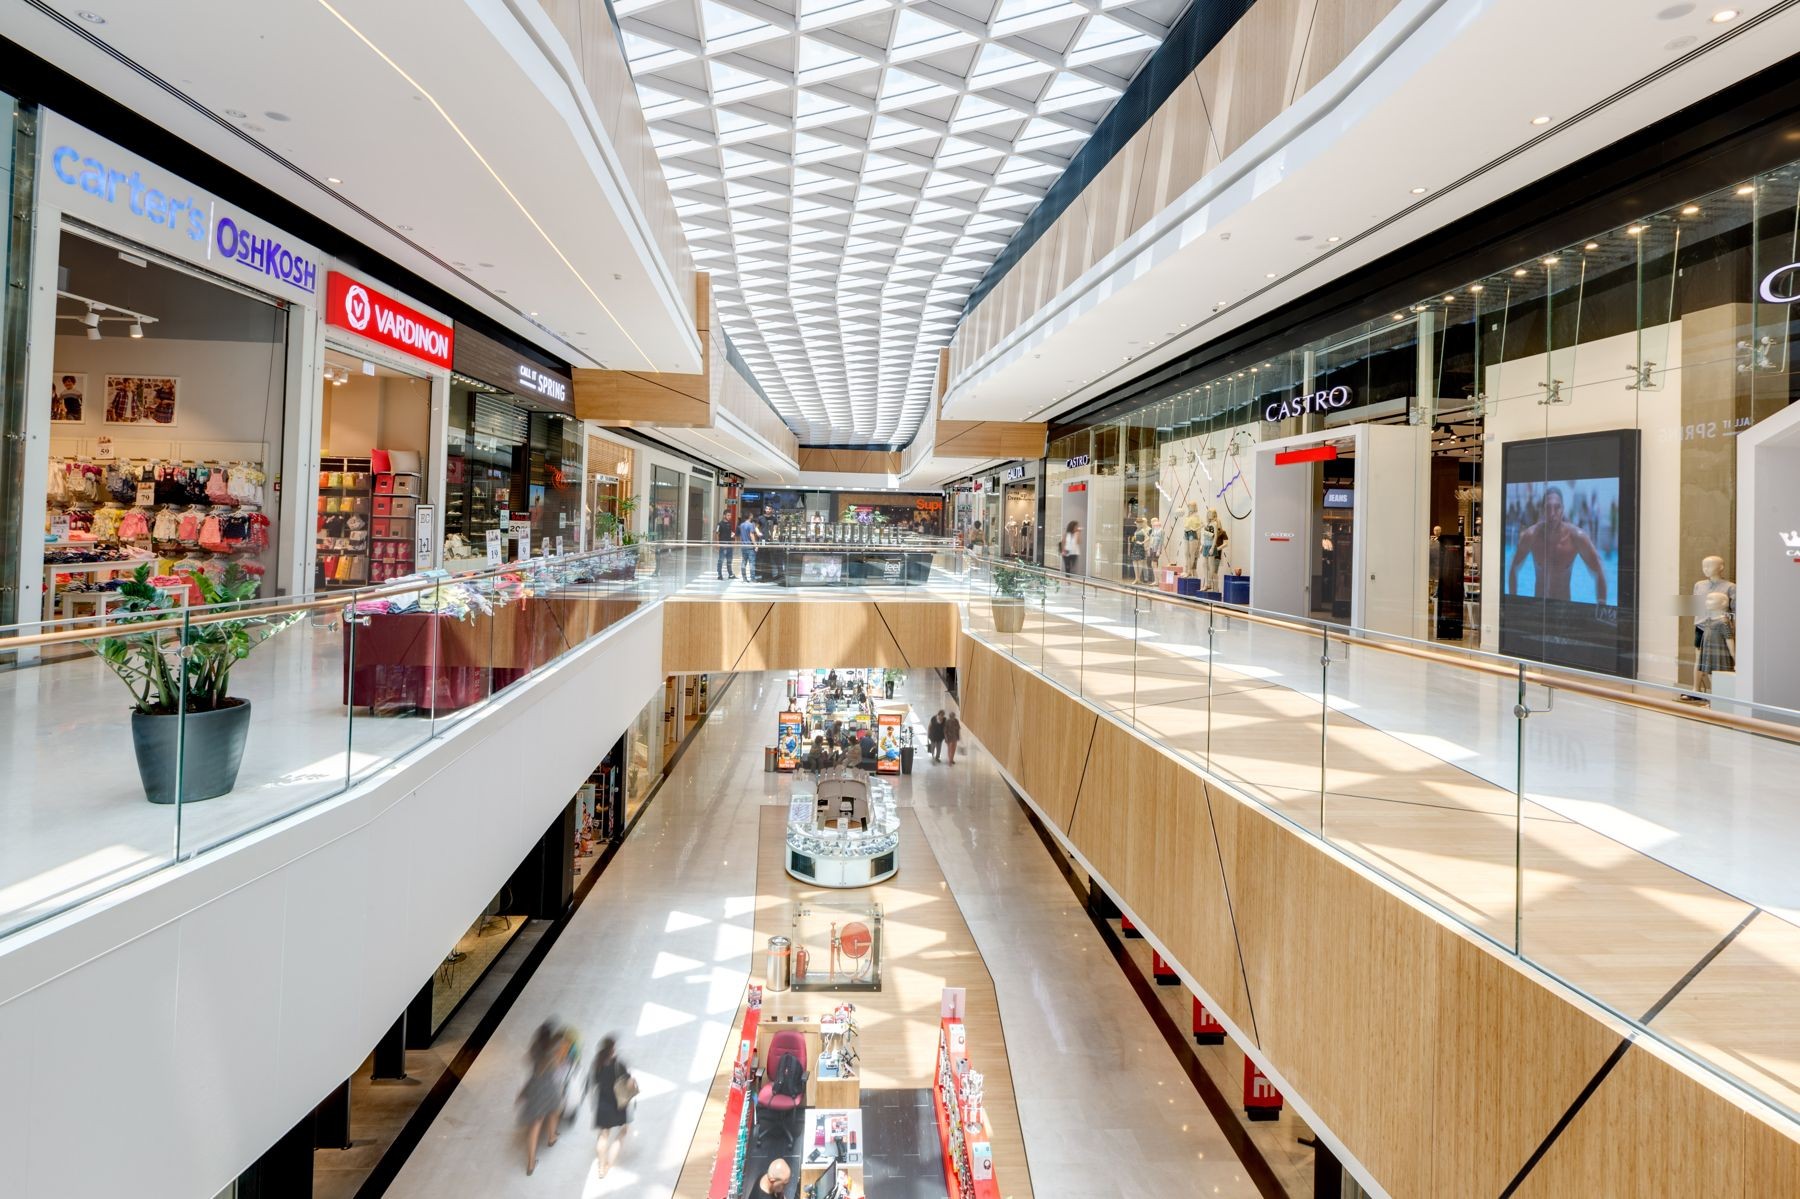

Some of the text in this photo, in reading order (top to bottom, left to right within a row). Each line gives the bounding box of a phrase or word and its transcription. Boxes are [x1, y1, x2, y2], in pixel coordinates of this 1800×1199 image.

[52, 145, 205, 241] carter's
[216, 217, 316, 293] OSHKOSH
[374, 304, 449, 360] VARDINON
[520, 365, 531, 379] CALL
[538, 374, 566, 401] SPRING
[1265, 386, 1348, 422] CASTRO
[1066, 455, 1088, 469] CASTRO
[1328, 494, 1348, 502] JEANS
